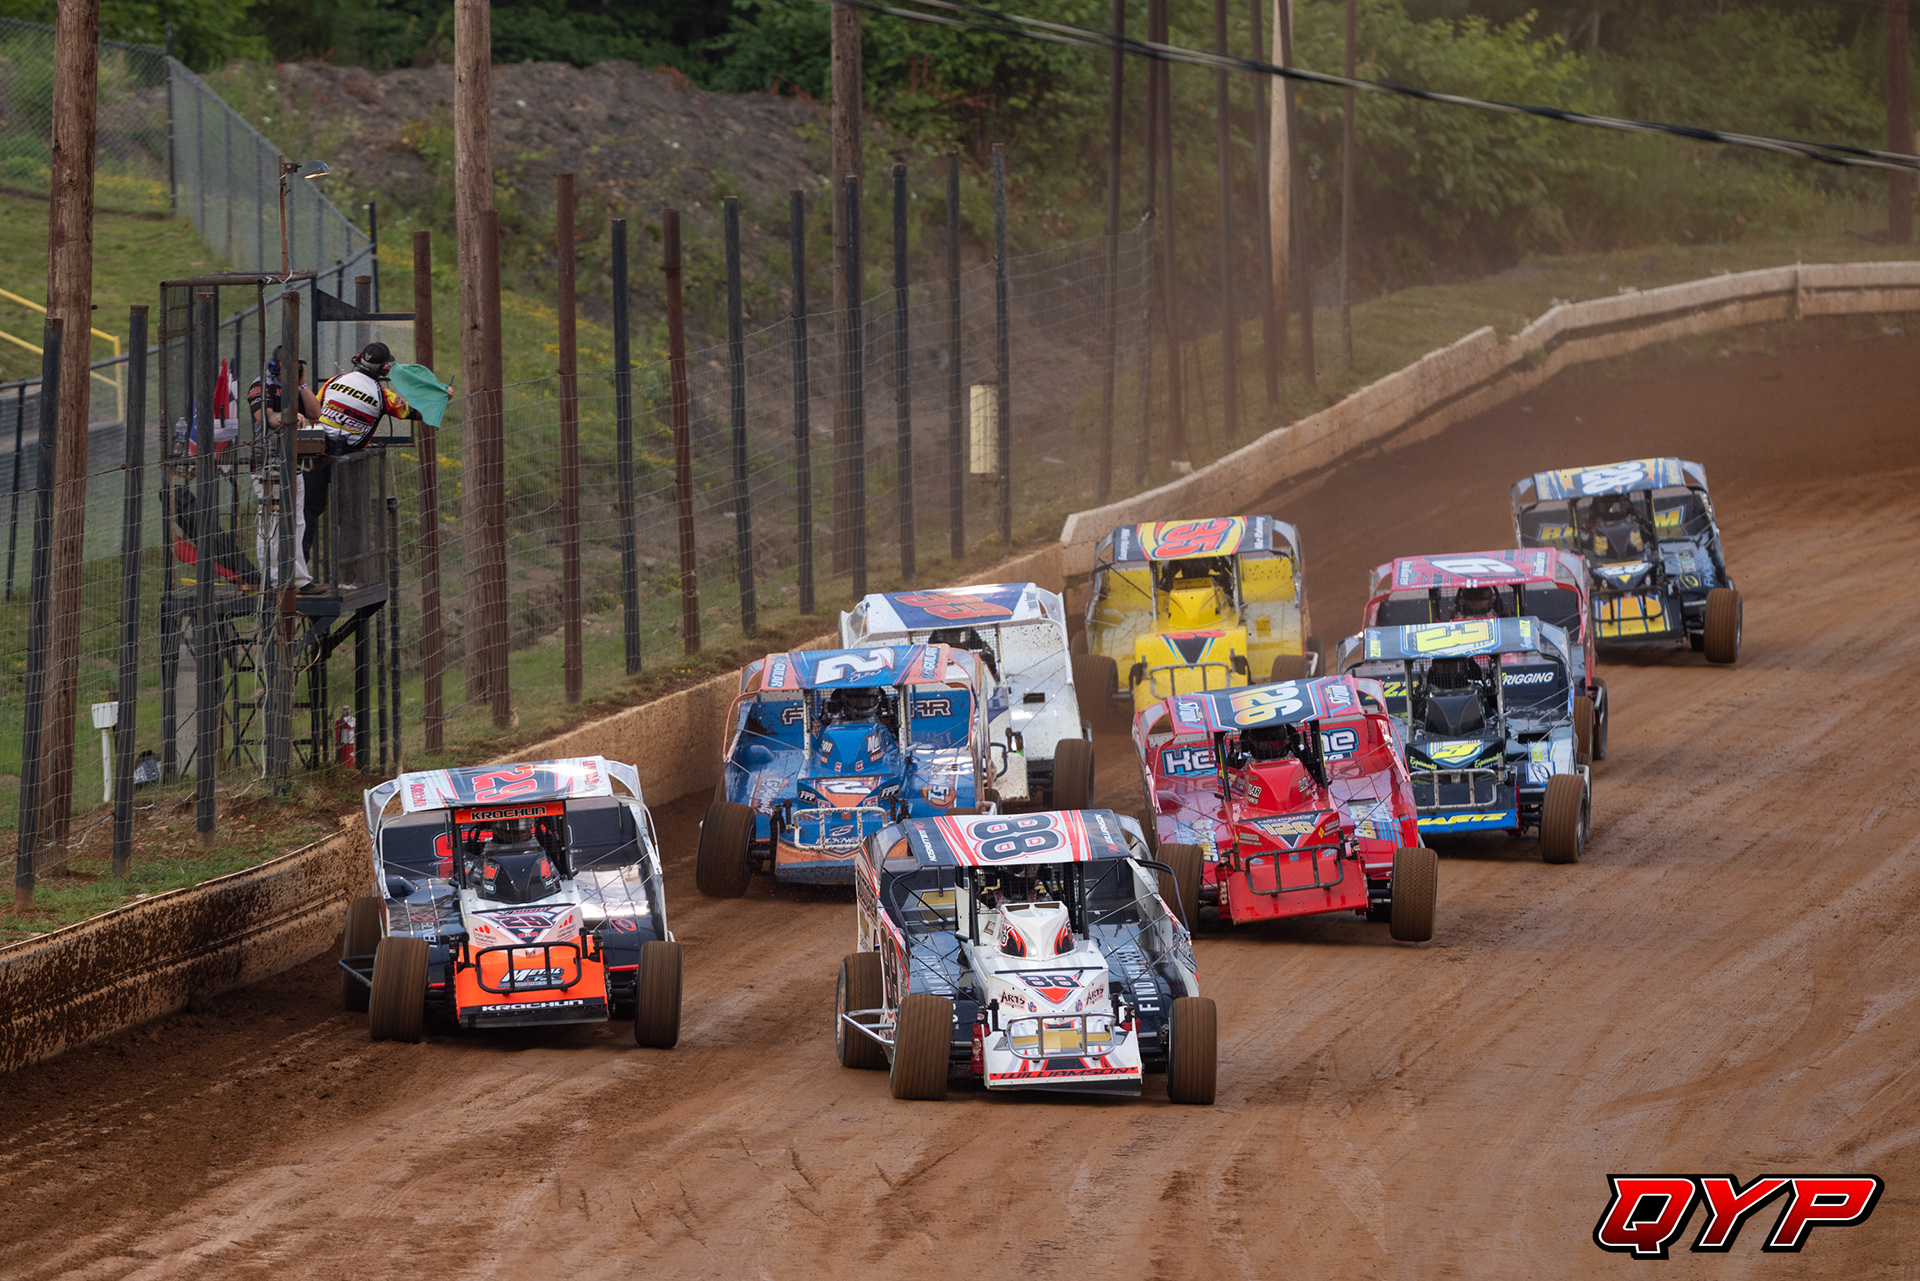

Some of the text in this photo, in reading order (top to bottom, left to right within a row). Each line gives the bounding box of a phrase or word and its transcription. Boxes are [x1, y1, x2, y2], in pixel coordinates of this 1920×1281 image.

[331, 382, 378, 408] OFFICIAL
[1582, 461, 1644, 494] 28
[1155, 518, 1232, 558] 35
[1416, 622, 1489, 653] 3
[815, 647, 894, 686] 2
[1502, 672, 1555, 686] RIGGING
[1230, 681, 1303, 726] 126
[472, 766, 538, 803] 29
[881, 784, 900, 798] FPP
[801, 790, 816, 802] FPP
[470, 806, 547, 821] KRACHUN
[970, 813, 1064, 861] 88
[1261, 821, 1316, 836] 126
[500, 915, 554, 929] 29
[1019, 974, 1083, 988] 88
[1000, 990, 1026, 1007] ARTS
[1086, 985, 1105, 1007] ARTS
[1133, 981, 1161, 1012] FIND
[482, 1000, 583, 1012] KRACHUN
[999, 1066, 1130, 1080] WILLIAMSON
